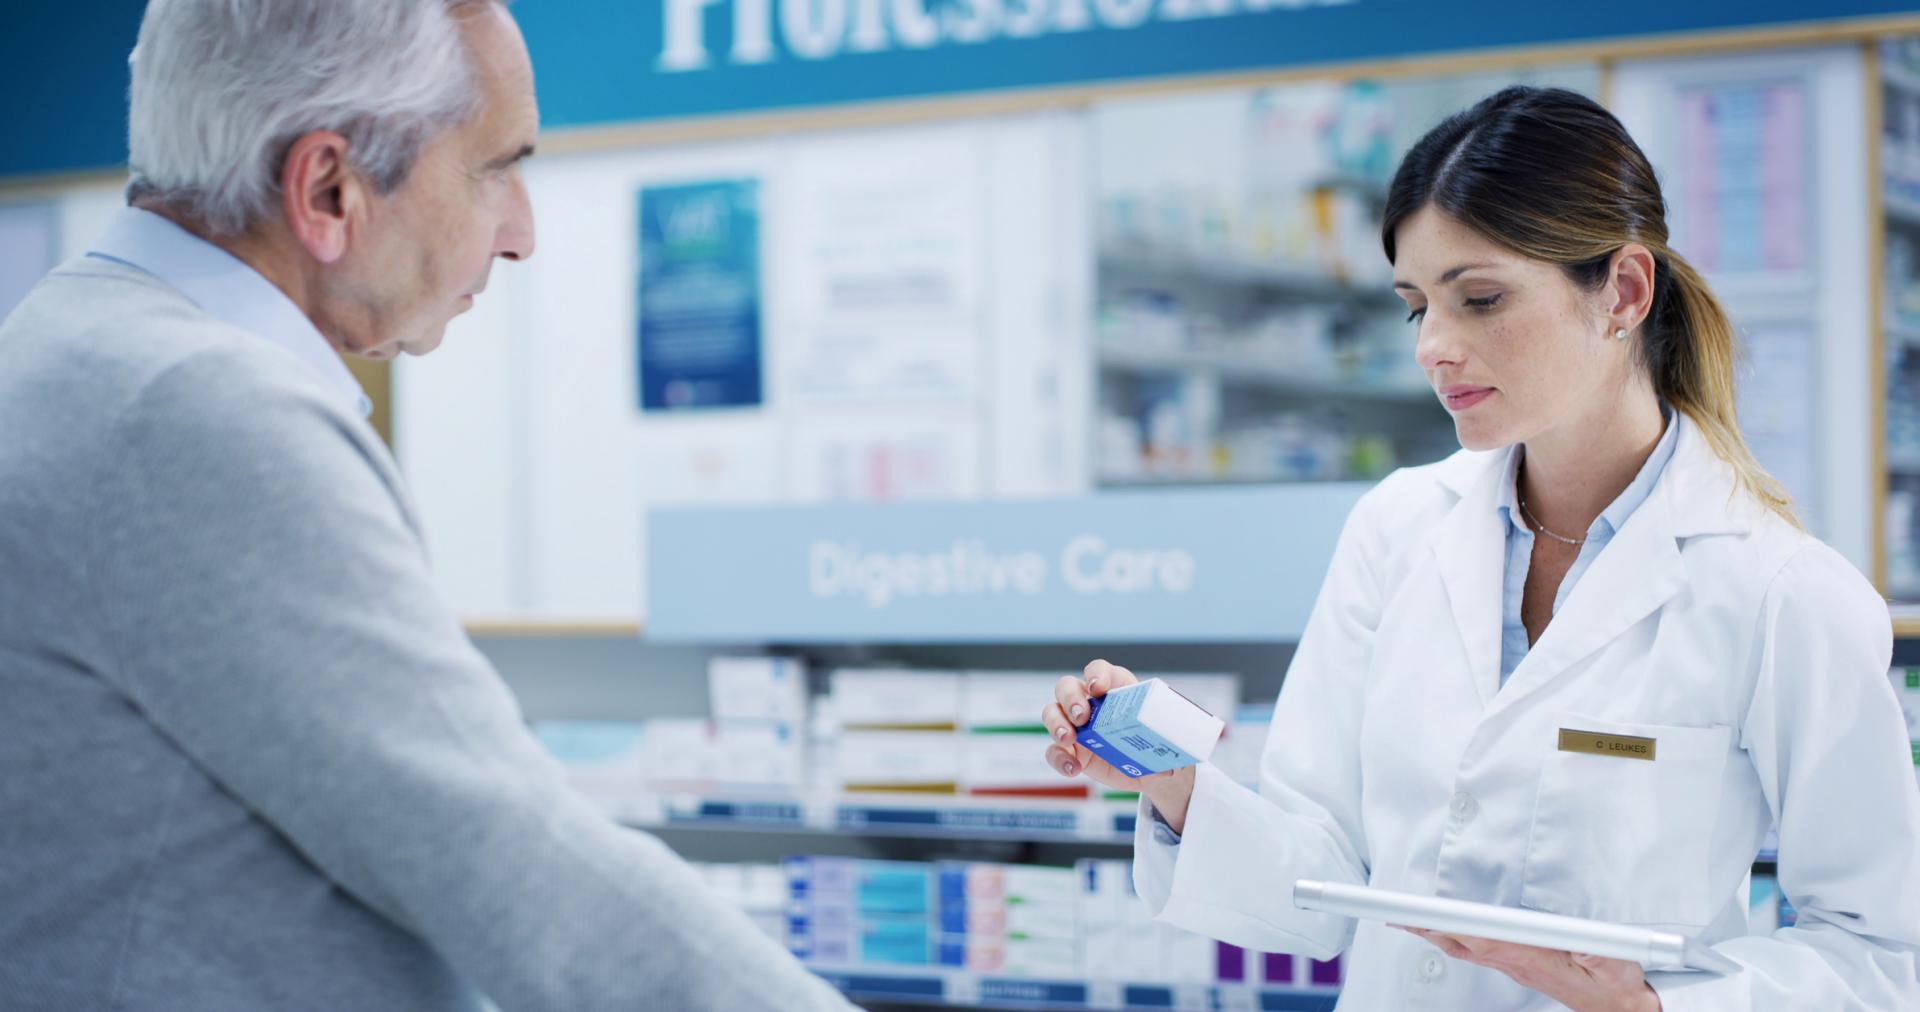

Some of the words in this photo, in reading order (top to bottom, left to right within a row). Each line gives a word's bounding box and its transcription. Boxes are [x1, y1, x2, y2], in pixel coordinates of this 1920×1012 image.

[810, 536, 1046, 607] Digestive
[1061, 534, 1194, 593] Care
[1595, 740, 1604, 749] C
[1609, 742, 1648, 754] LEUKES
